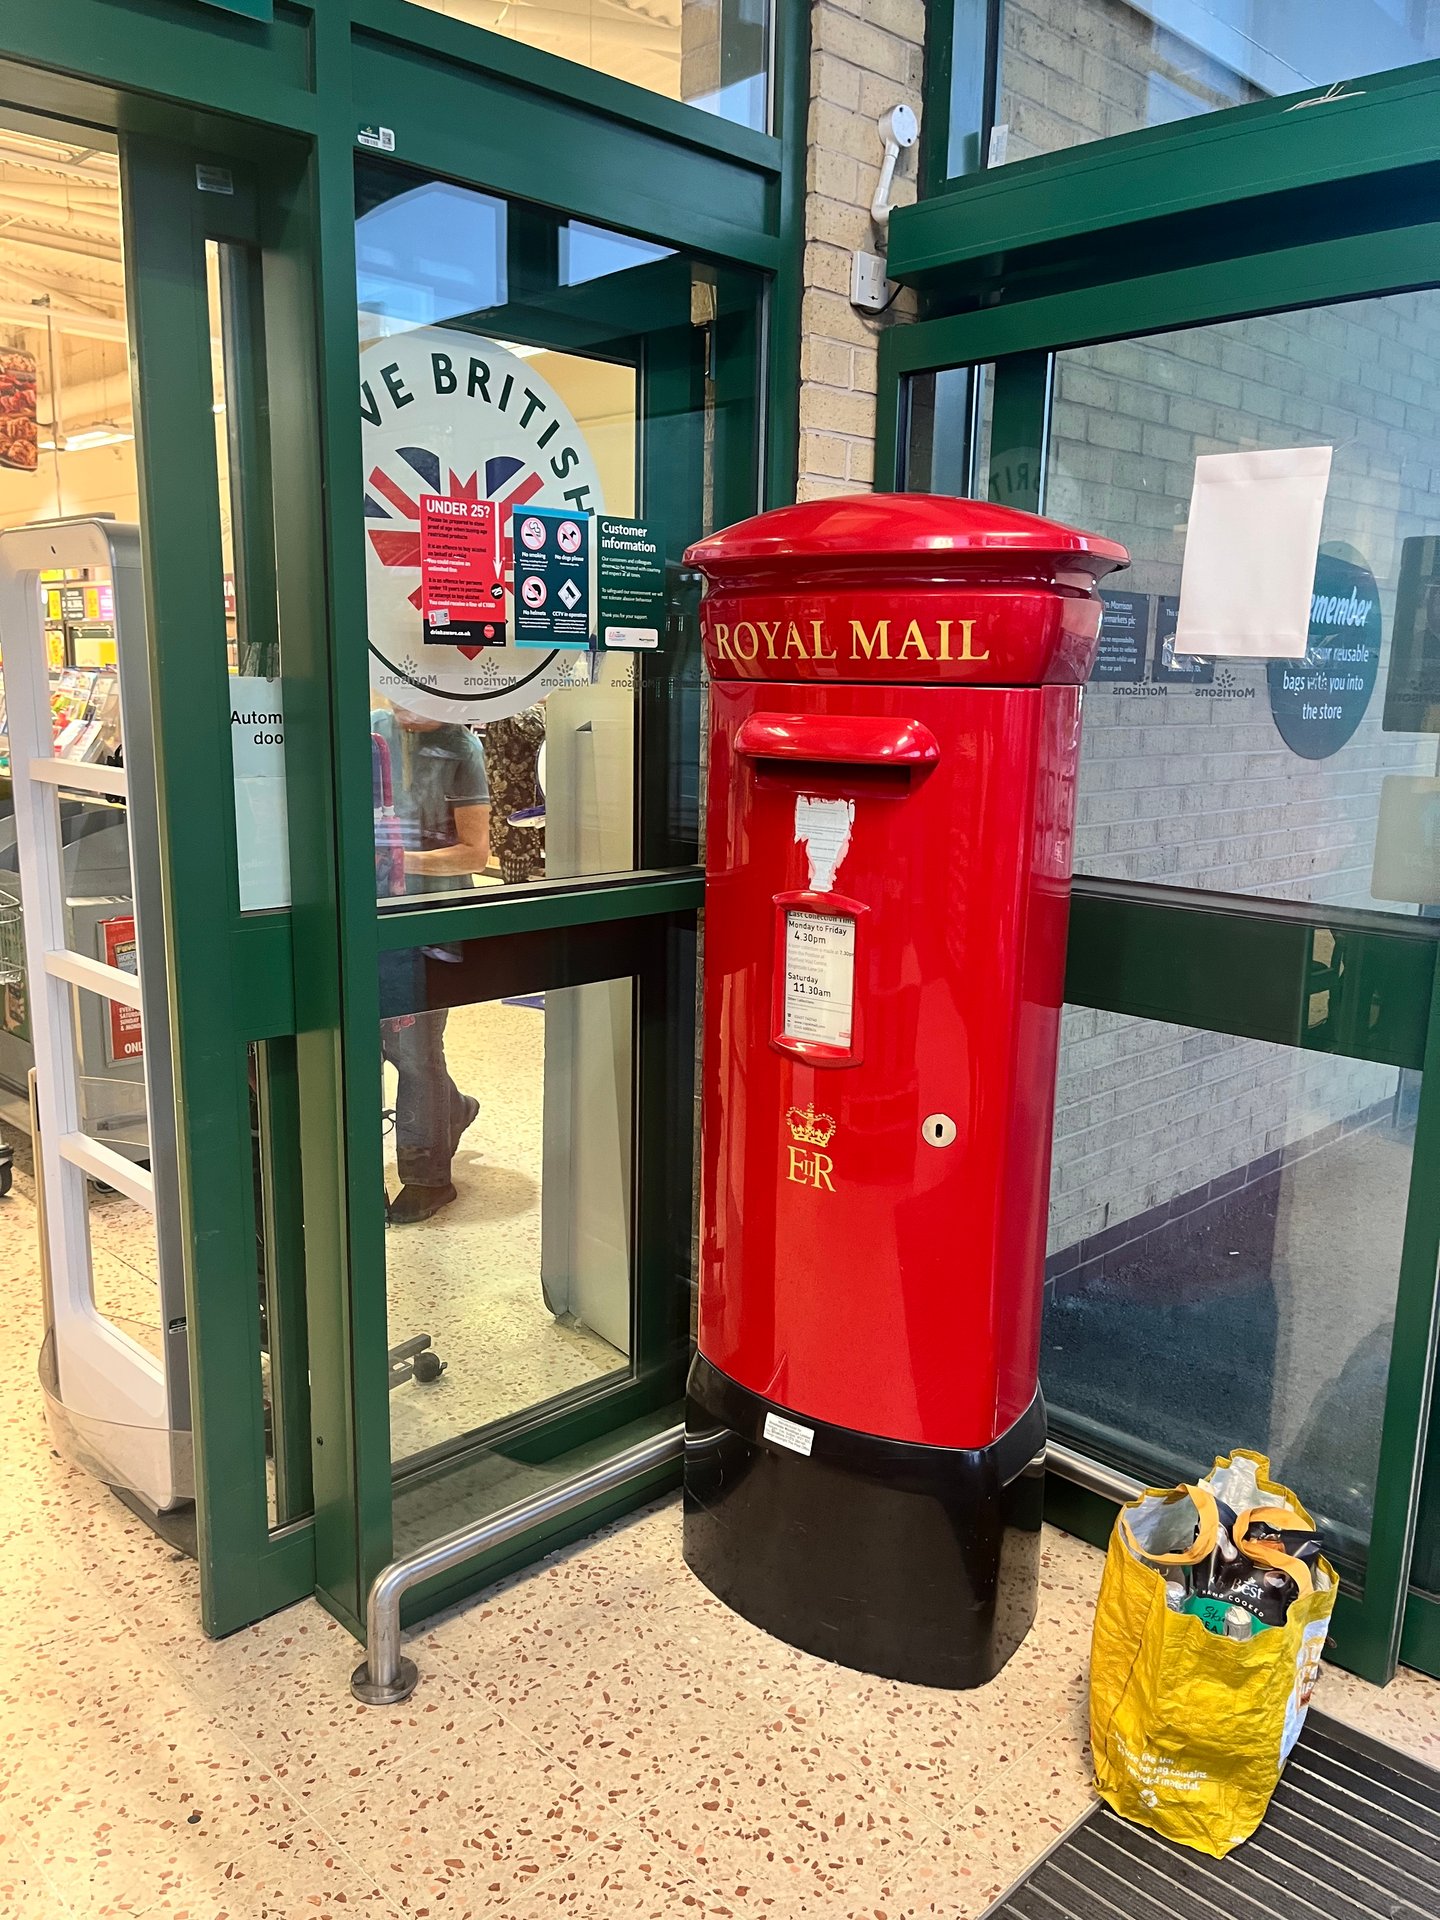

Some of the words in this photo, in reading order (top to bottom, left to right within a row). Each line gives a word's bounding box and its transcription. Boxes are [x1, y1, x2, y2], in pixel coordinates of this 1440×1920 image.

[360, 362, 415, 427] VE
[431, 352, 595, 517] BRITISH
[426, 499, 467, 516] UNDER
[470, 504, 490, 518] 25?
[602, 521, 647, 538] Customer
[602, 536, 656, 552] information
[1310, 586, 1372, 627] member
[714, 620, 837, 660] ROYAL
[848, 619, 990, 660] MAIL
[1333, 644, 1369, 662] reusable
[1283, 671, 1305, 692] bags
[1329, 677, 1346, 694] you
[1347, 674, 1364, 690] into
[230, 710, 282, 724] Autom
[1302, 702, 1318, 720] the
[1318, 702, 1342, 720] store
[254, 731, 284, 744] doo
[789, 920, 815, 931] Monday
[825, 925, 847, 936] Friday
[794, 930, 826, 944] 4.30pm
[788, 972, 818, 984] Saturday
[793, 982, 831, 998] 11.30am
[124, 1042, 143, 1054] ONL
[1231, 1578, 1264, 1600] Best
[1201, 1590, 1224, 1598] HAND
[1228, 1595, 1264, 1617] COOKED
